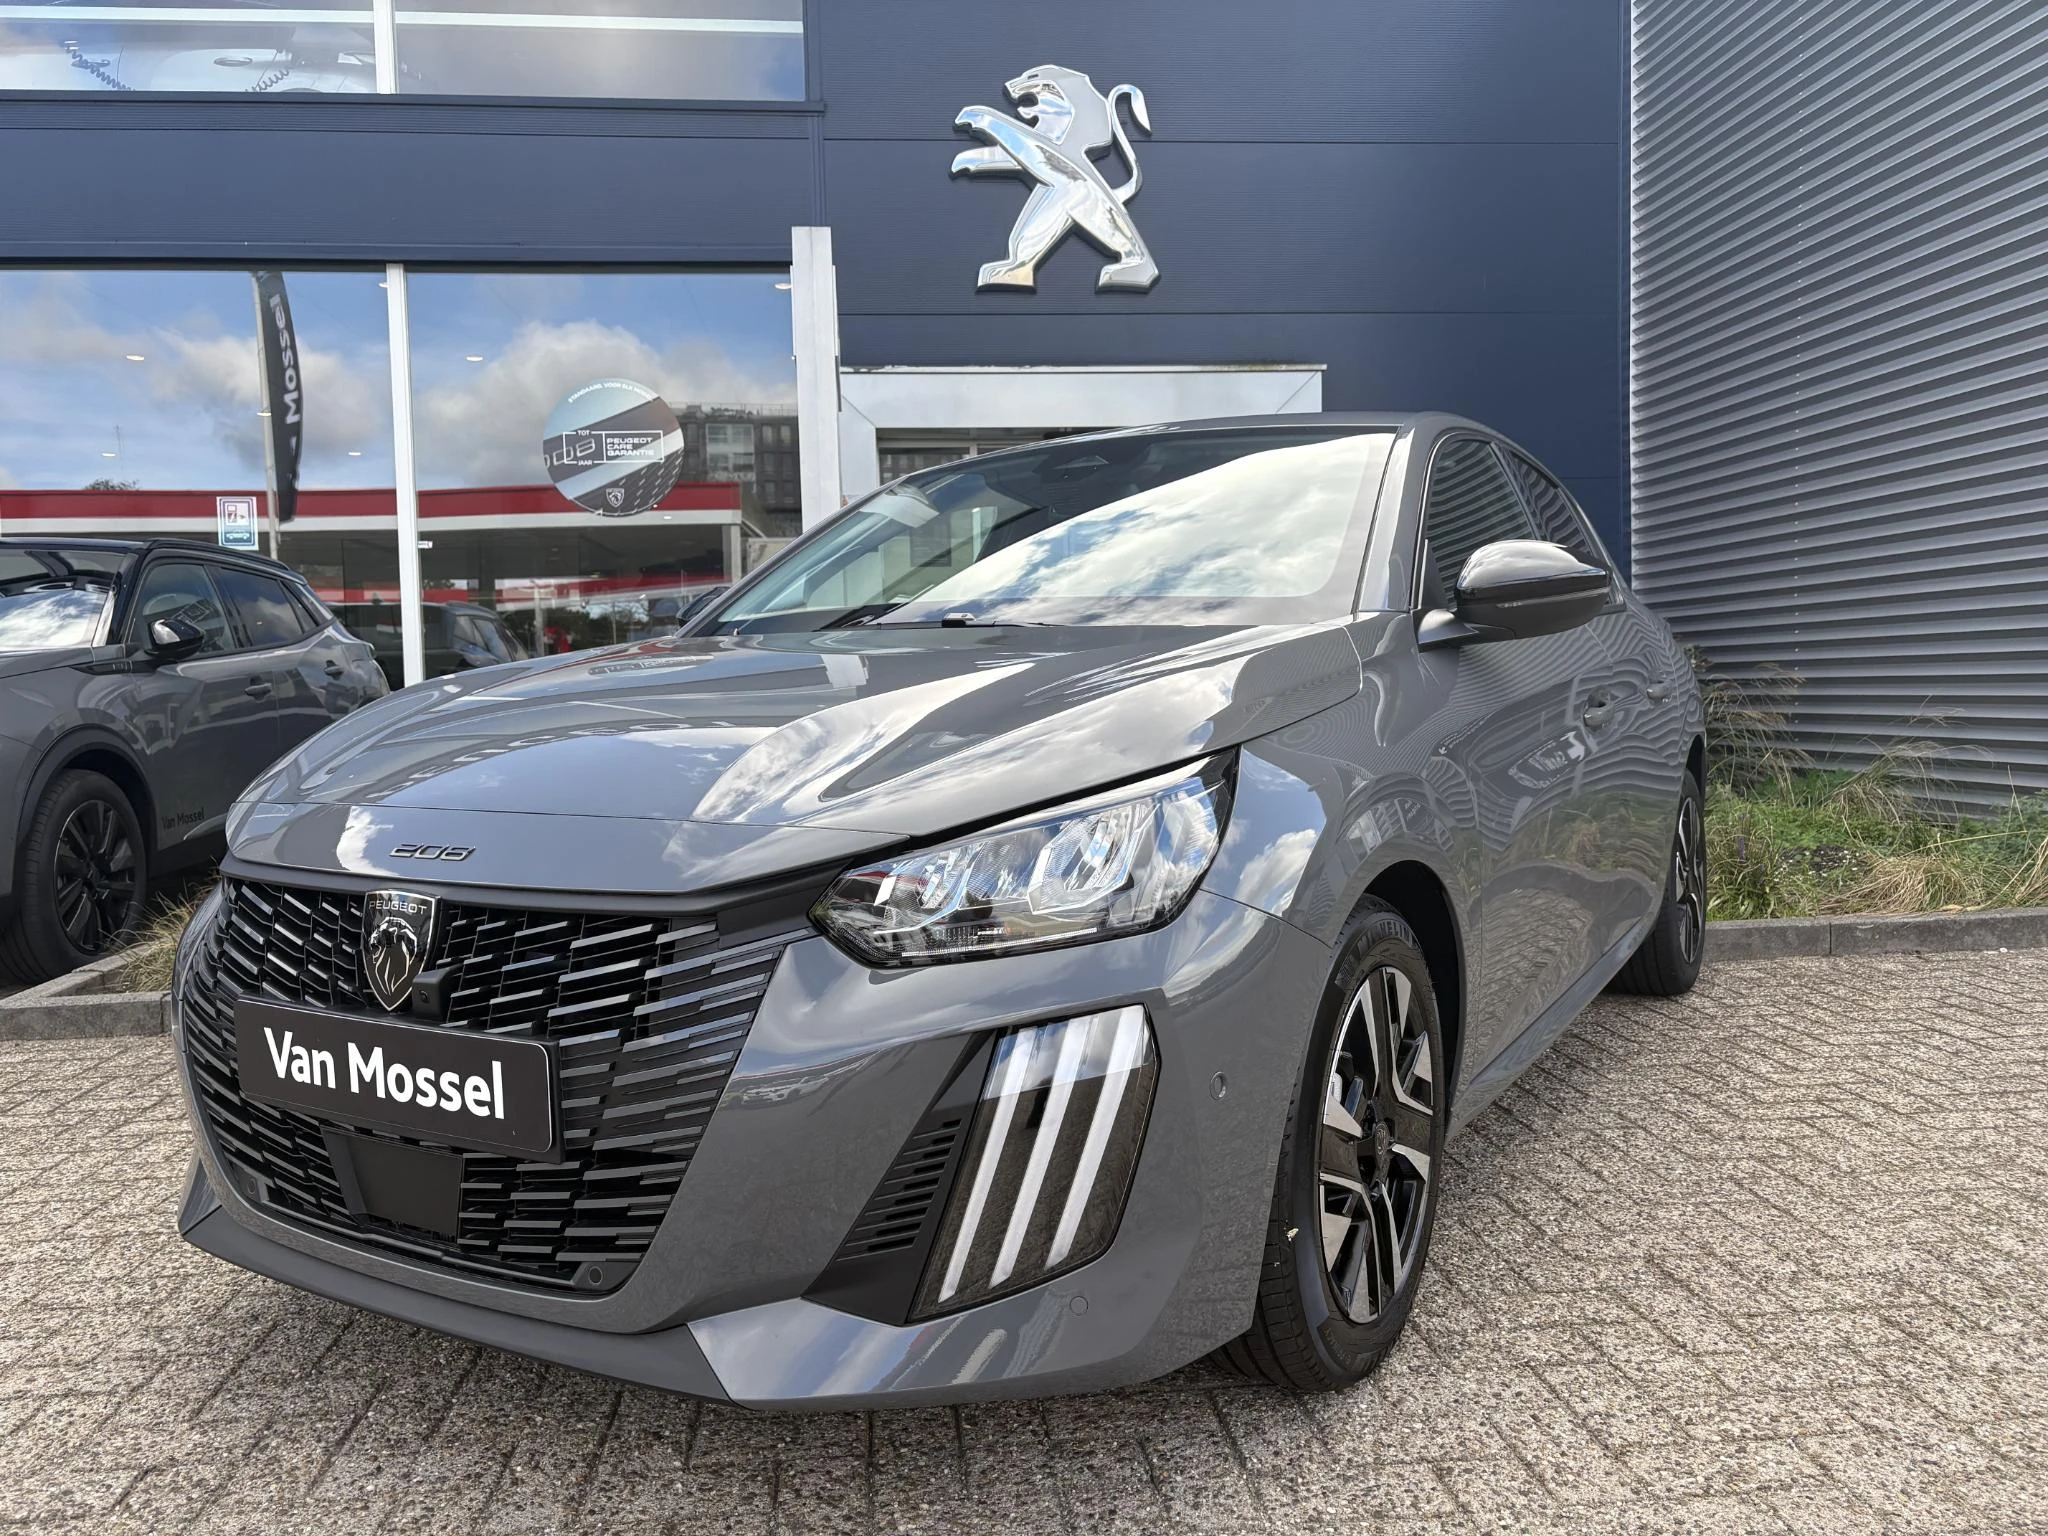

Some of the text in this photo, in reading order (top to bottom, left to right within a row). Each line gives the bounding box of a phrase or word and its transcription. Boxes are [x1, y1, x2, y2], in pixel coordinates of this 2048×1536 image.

[269, 294, 300, 425] Mossel
[603, 381, 622, 389] VOOR
[606, 449, 656, 457] GARANTIE
[162, 807, 205, 830] Van Mossel
[389, 843, 476, 862] 208
[369, 900, 428, 915] PEUGEOT
[264, 1027, 505, 1120] Van Mossel
